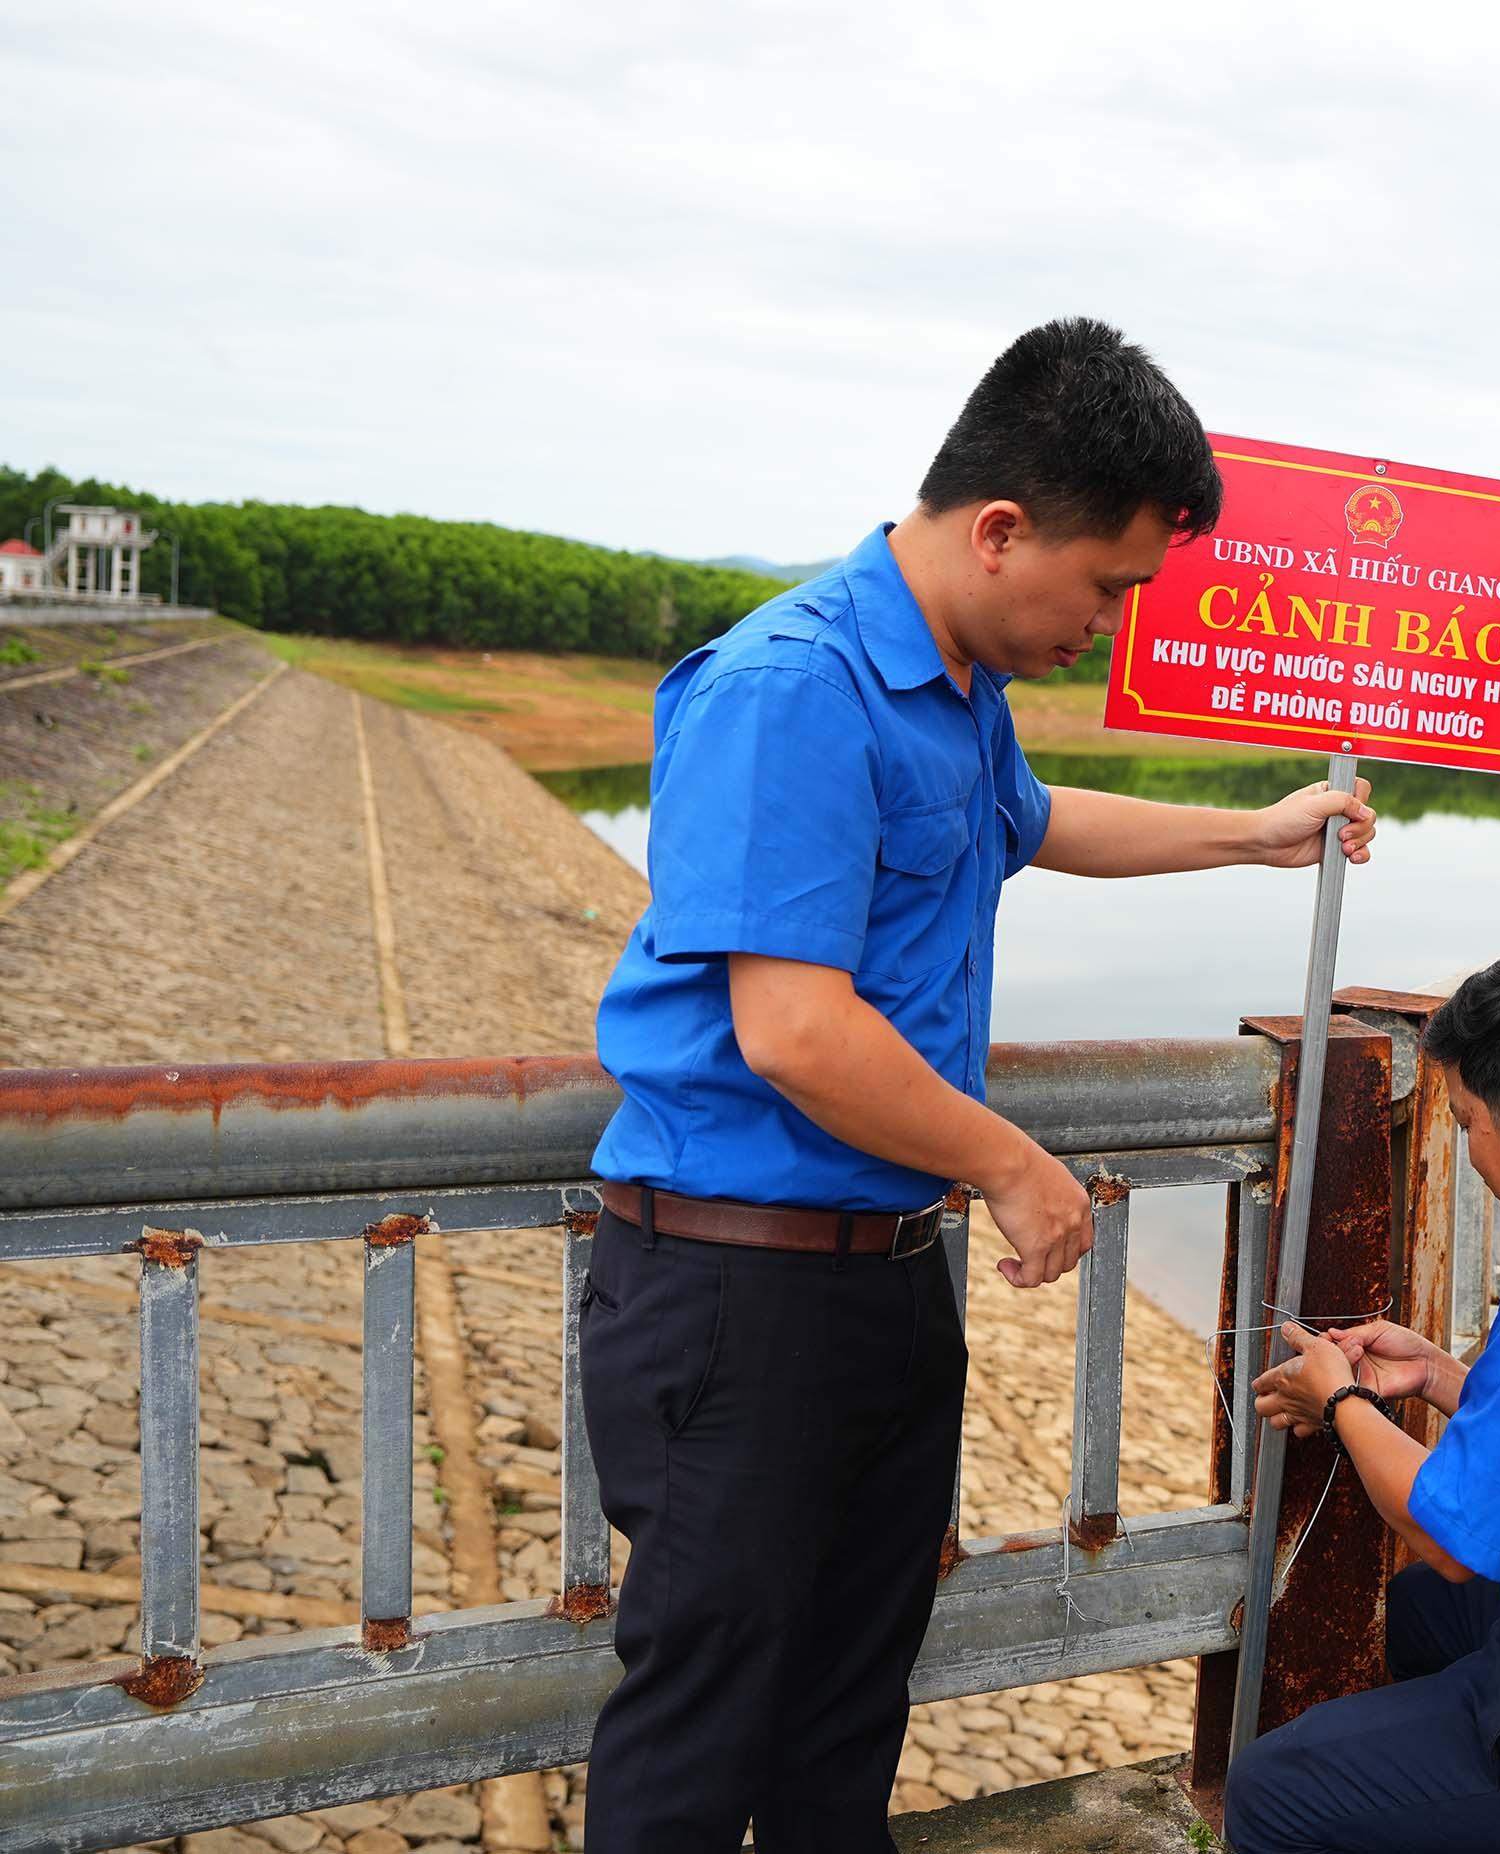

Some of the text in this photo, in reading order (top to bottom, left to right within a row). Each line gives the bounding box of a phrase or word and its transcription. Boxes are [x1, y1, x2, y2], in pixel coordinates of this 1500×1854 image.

[1213, 538, 1294, 569] UBND
[1301, 548, 1339, 576] XÃ
[1348, 554, 1421, 587] HIẾU
[1198, 572, 1376, 648] CẢNH
[1152, 638, 1207, 667] KHU
[1215, 645, 1266, 677] VỰC
[1273, 653, 1345, 683] NƯỚC
[1352, 661, 1404, 691] SÂU
[1410, 670, 1478, 700] NGUY
[1211, 681, 1484, 740] ĐỀ PHÒNG ĐUỐI NƯỚC
